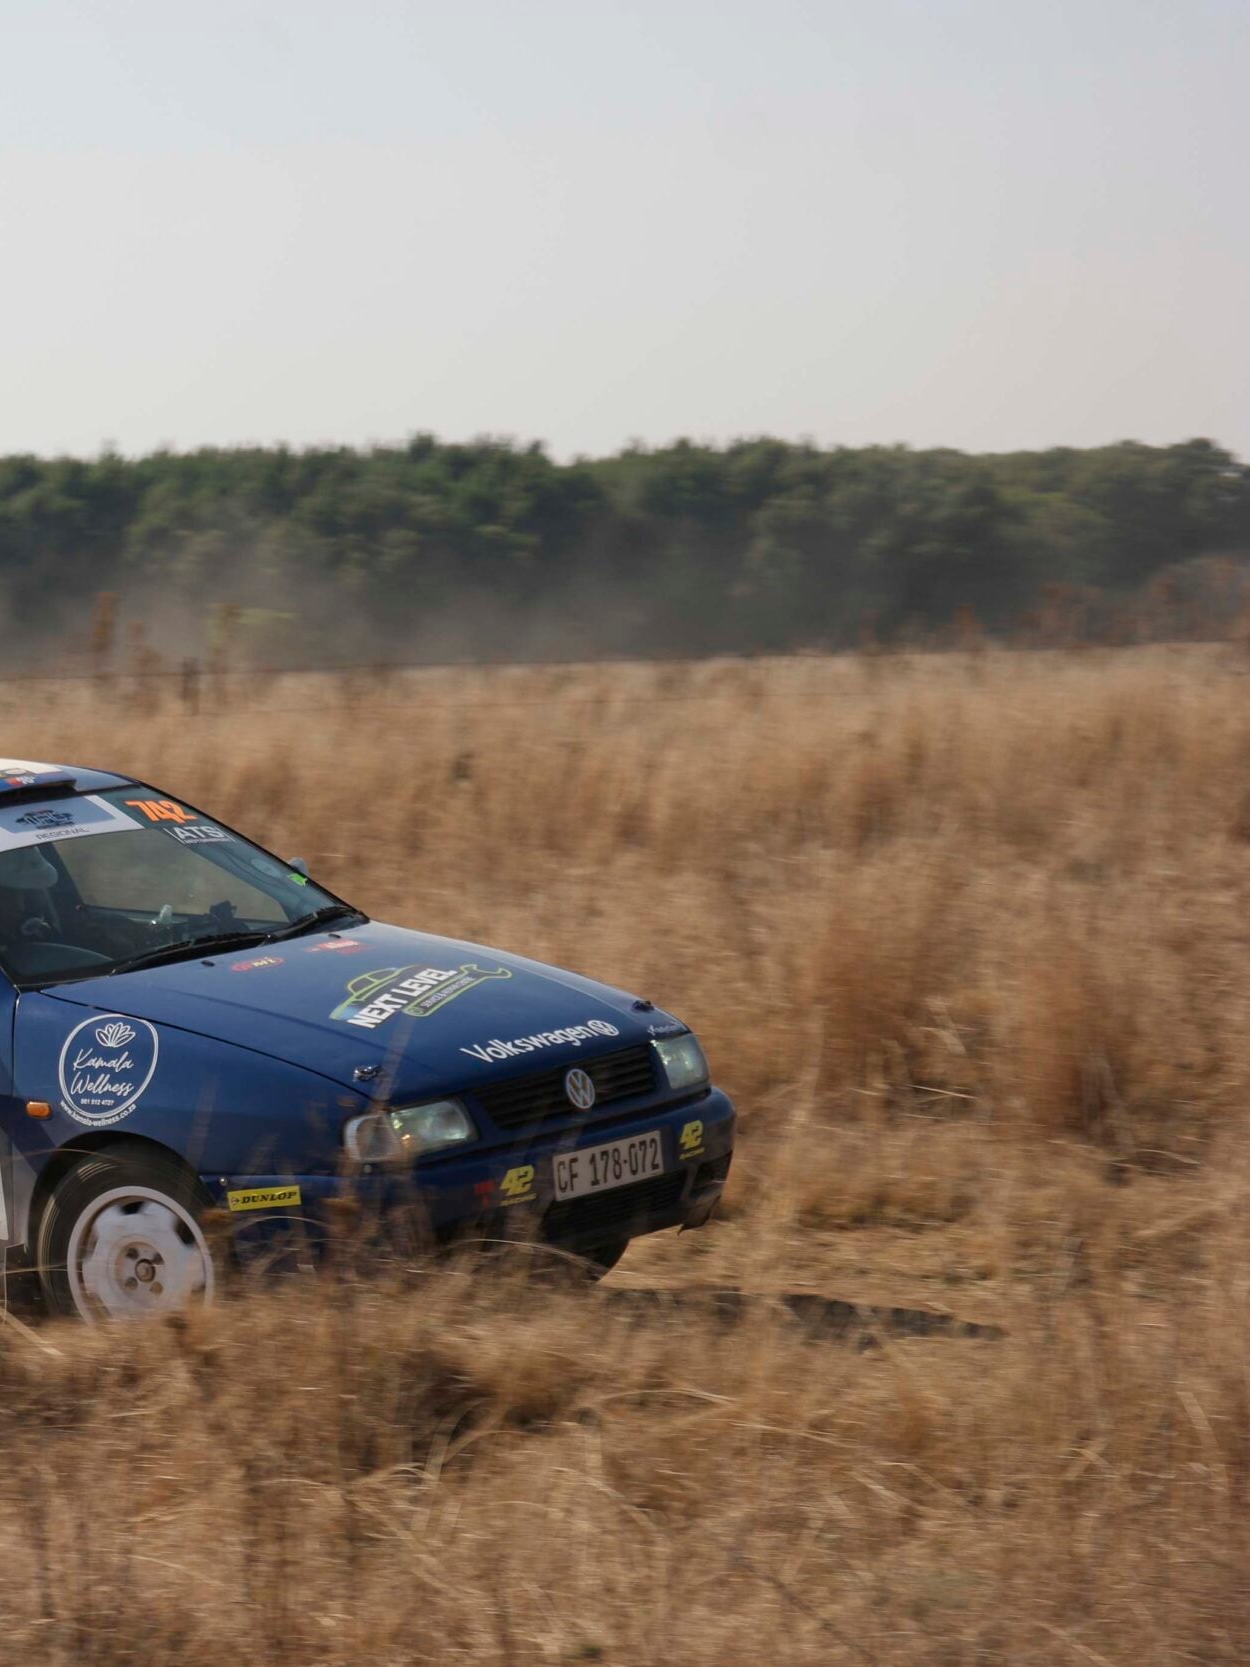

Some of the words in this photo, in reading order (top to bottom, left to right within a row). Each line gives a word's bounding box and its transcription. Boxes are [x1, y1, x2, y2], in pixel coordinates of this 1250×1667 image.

[126, 800, 198, 824] 742
[36, 827, 90, 840] REGIONAL
[173, 825, 224, 839] ATS
[347, 993, 408, 1029] NEXT
[391, 968, 458, 998] LEVEL
[460, 1024, 593, 1063] Volkswagen
[73, 1048, 134, 1072] Kamala
[70, 1071, 134, 1096] Wellness
[680, 1120, 703, 1149] 42
[556, 1158, 578, 1193] CF
[589, 1138, 660, 1187] 178-072
[500, 1165, 534, 1196] 42
[241, 1191, 297, 1205] DUNLOP
